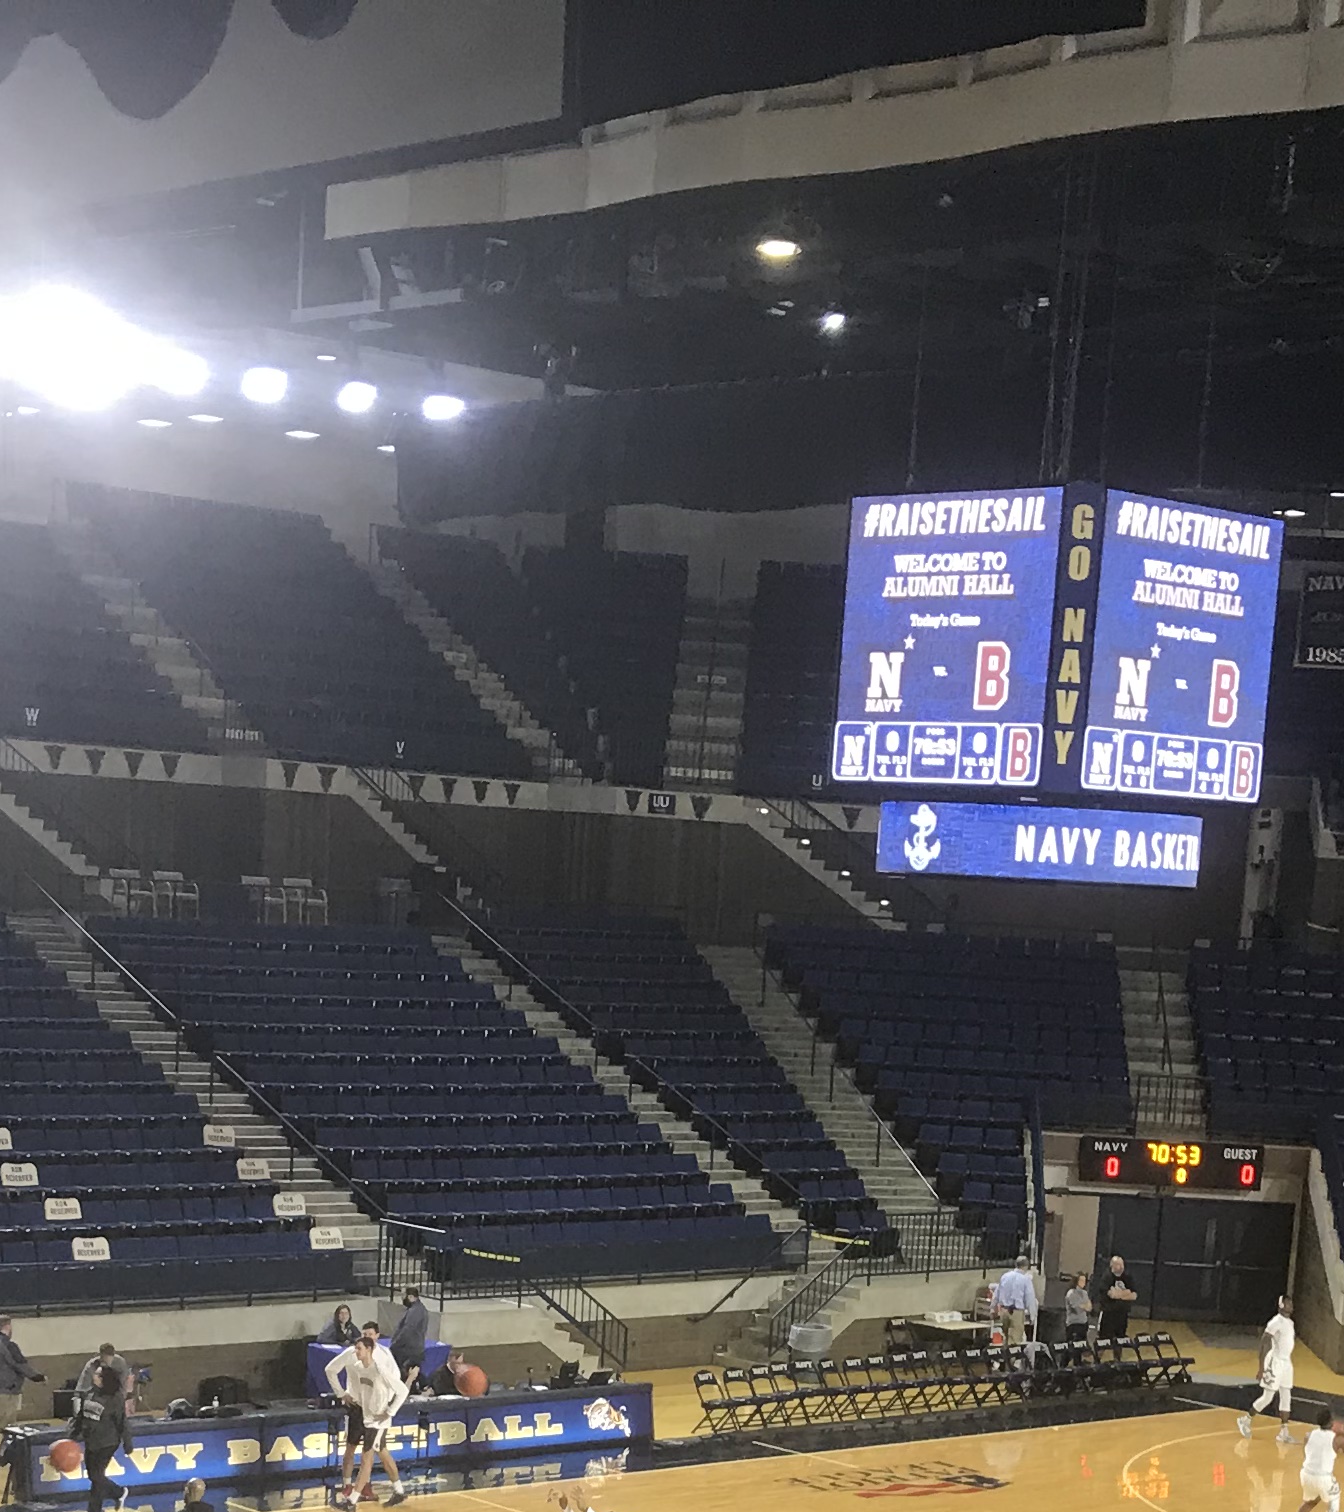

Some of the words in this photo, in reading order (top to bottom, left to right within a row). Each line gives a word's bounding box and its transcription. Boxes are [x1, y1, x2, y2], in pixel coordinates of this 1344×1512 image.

[863, 496, 1046, 537] #RAISETHESAIL
[1116, 501, 1270, 560] #RAISETHESAIL
[894, 552, 980, 573] WELCOME
[982, 551, 1007, 570] TO
[1144, 558, 1217, 589] WELCOME
[1218, 572, 1239, 591] TO
[882, 575, 960, 597] ALUMNI
[962, 574, 1014, 595] HALL
[1132, 580, 1201, 610] ALUMNI
[1202, 590, 1244, 616] HALL
[866, 651, 904, 698] N
[973, 641, 1011, 710] B
[1055, 607, 1086, 765] NAVY
[1115, 656, 1151, 707] N
[865, 698, 903, 712] NAVY
[1208, 659, 1241, 727] B
[25, 707, 40, 722] W
[396, 741, 405, 754] V
[1005, 728, 1032, 781] B
[812, 774, 823, 787] U
[1232, 746, 1255, 797] B
[1014, 824, 1101, 866] NAVY
[1094, 1141, 1128, 1152] NAVY
[1147, 1143, 1201, 1166] 70:53
[1223, 1147, 1258, 1160] GUEST
[1106, 1156, 1120, 1177] 0
[1240, 1164, 1255, 1185] 0
[227, 1412, 564, 1465] BASETBALL
